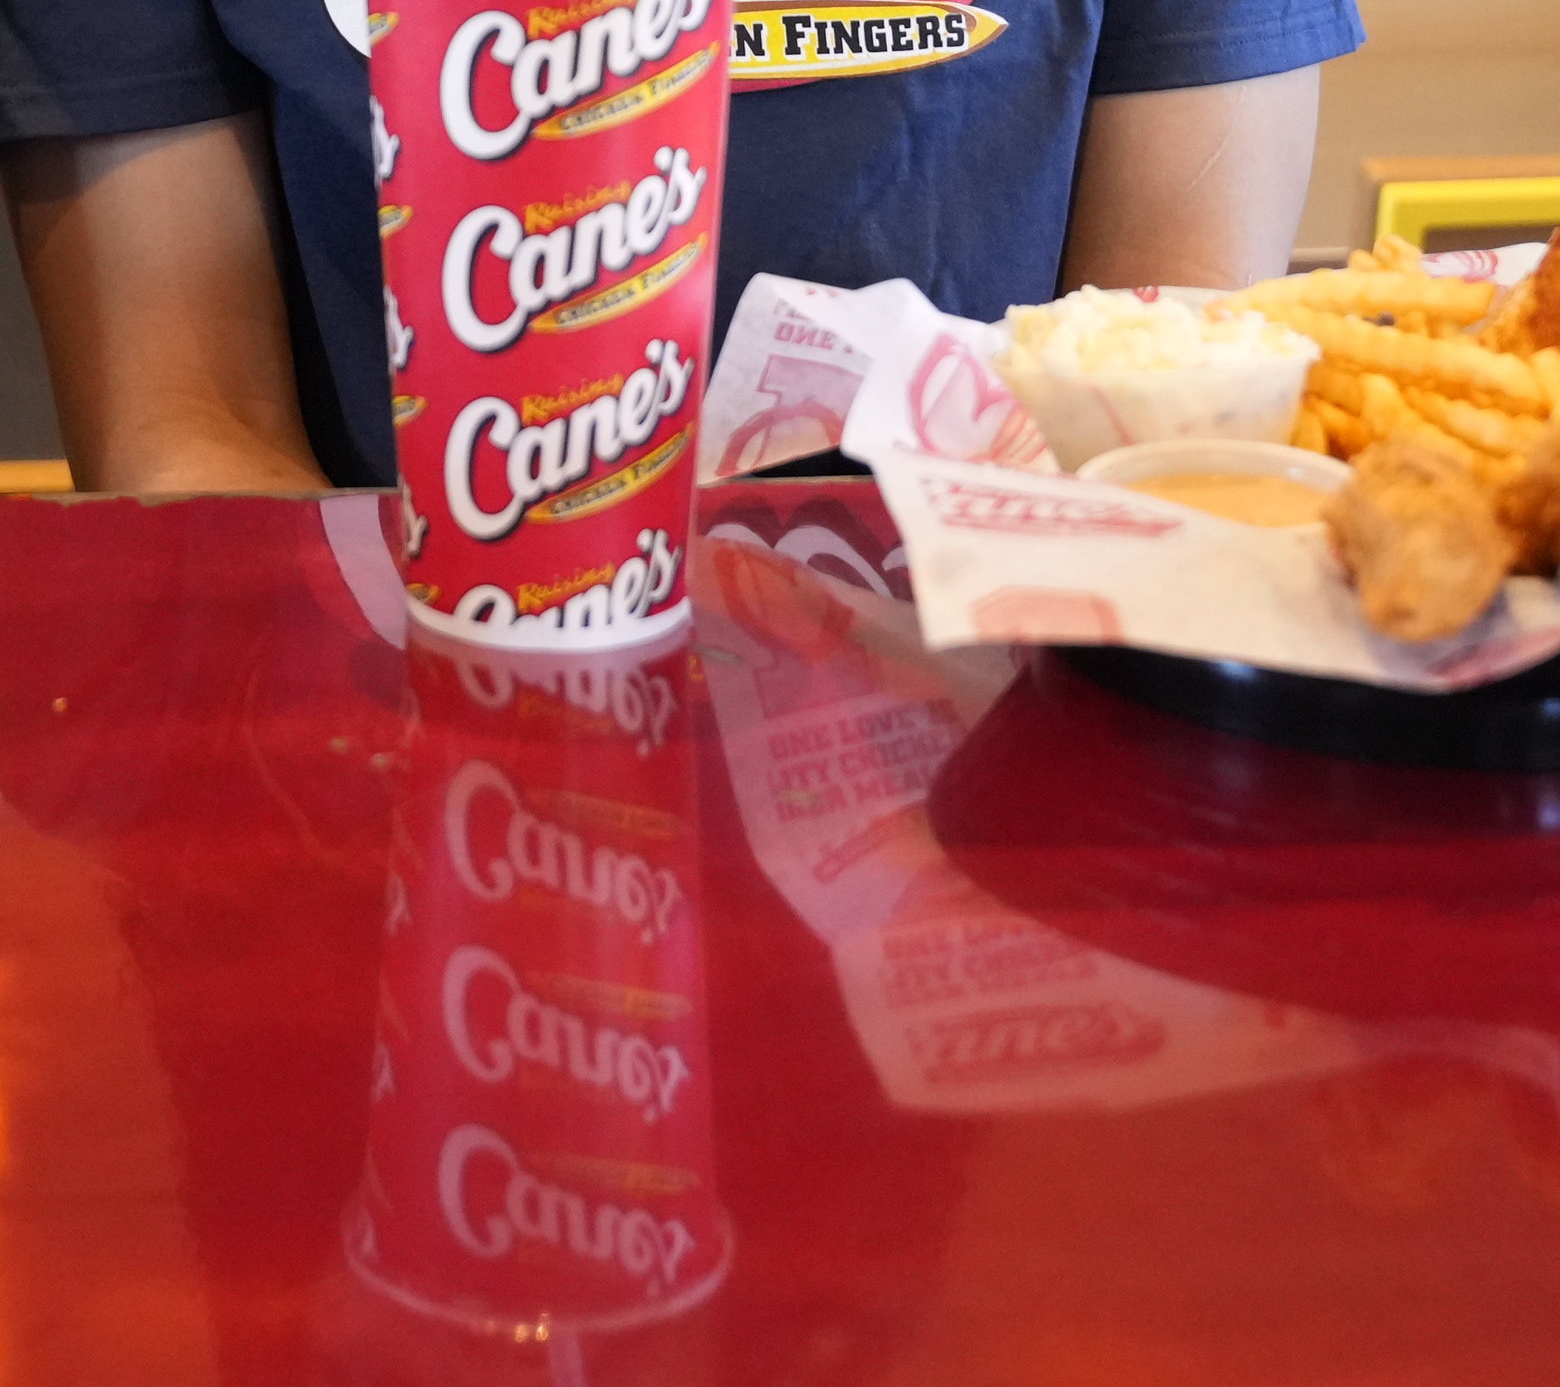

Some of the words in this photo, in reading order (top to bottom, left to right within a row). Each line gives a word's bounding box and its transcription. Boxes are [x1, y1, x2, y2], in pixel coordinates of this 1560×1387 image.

[786, 11, 966, 57] FINGERS
[441, 146, 707, 351] Cane's
[445, 339, 695, 542] Cane's
